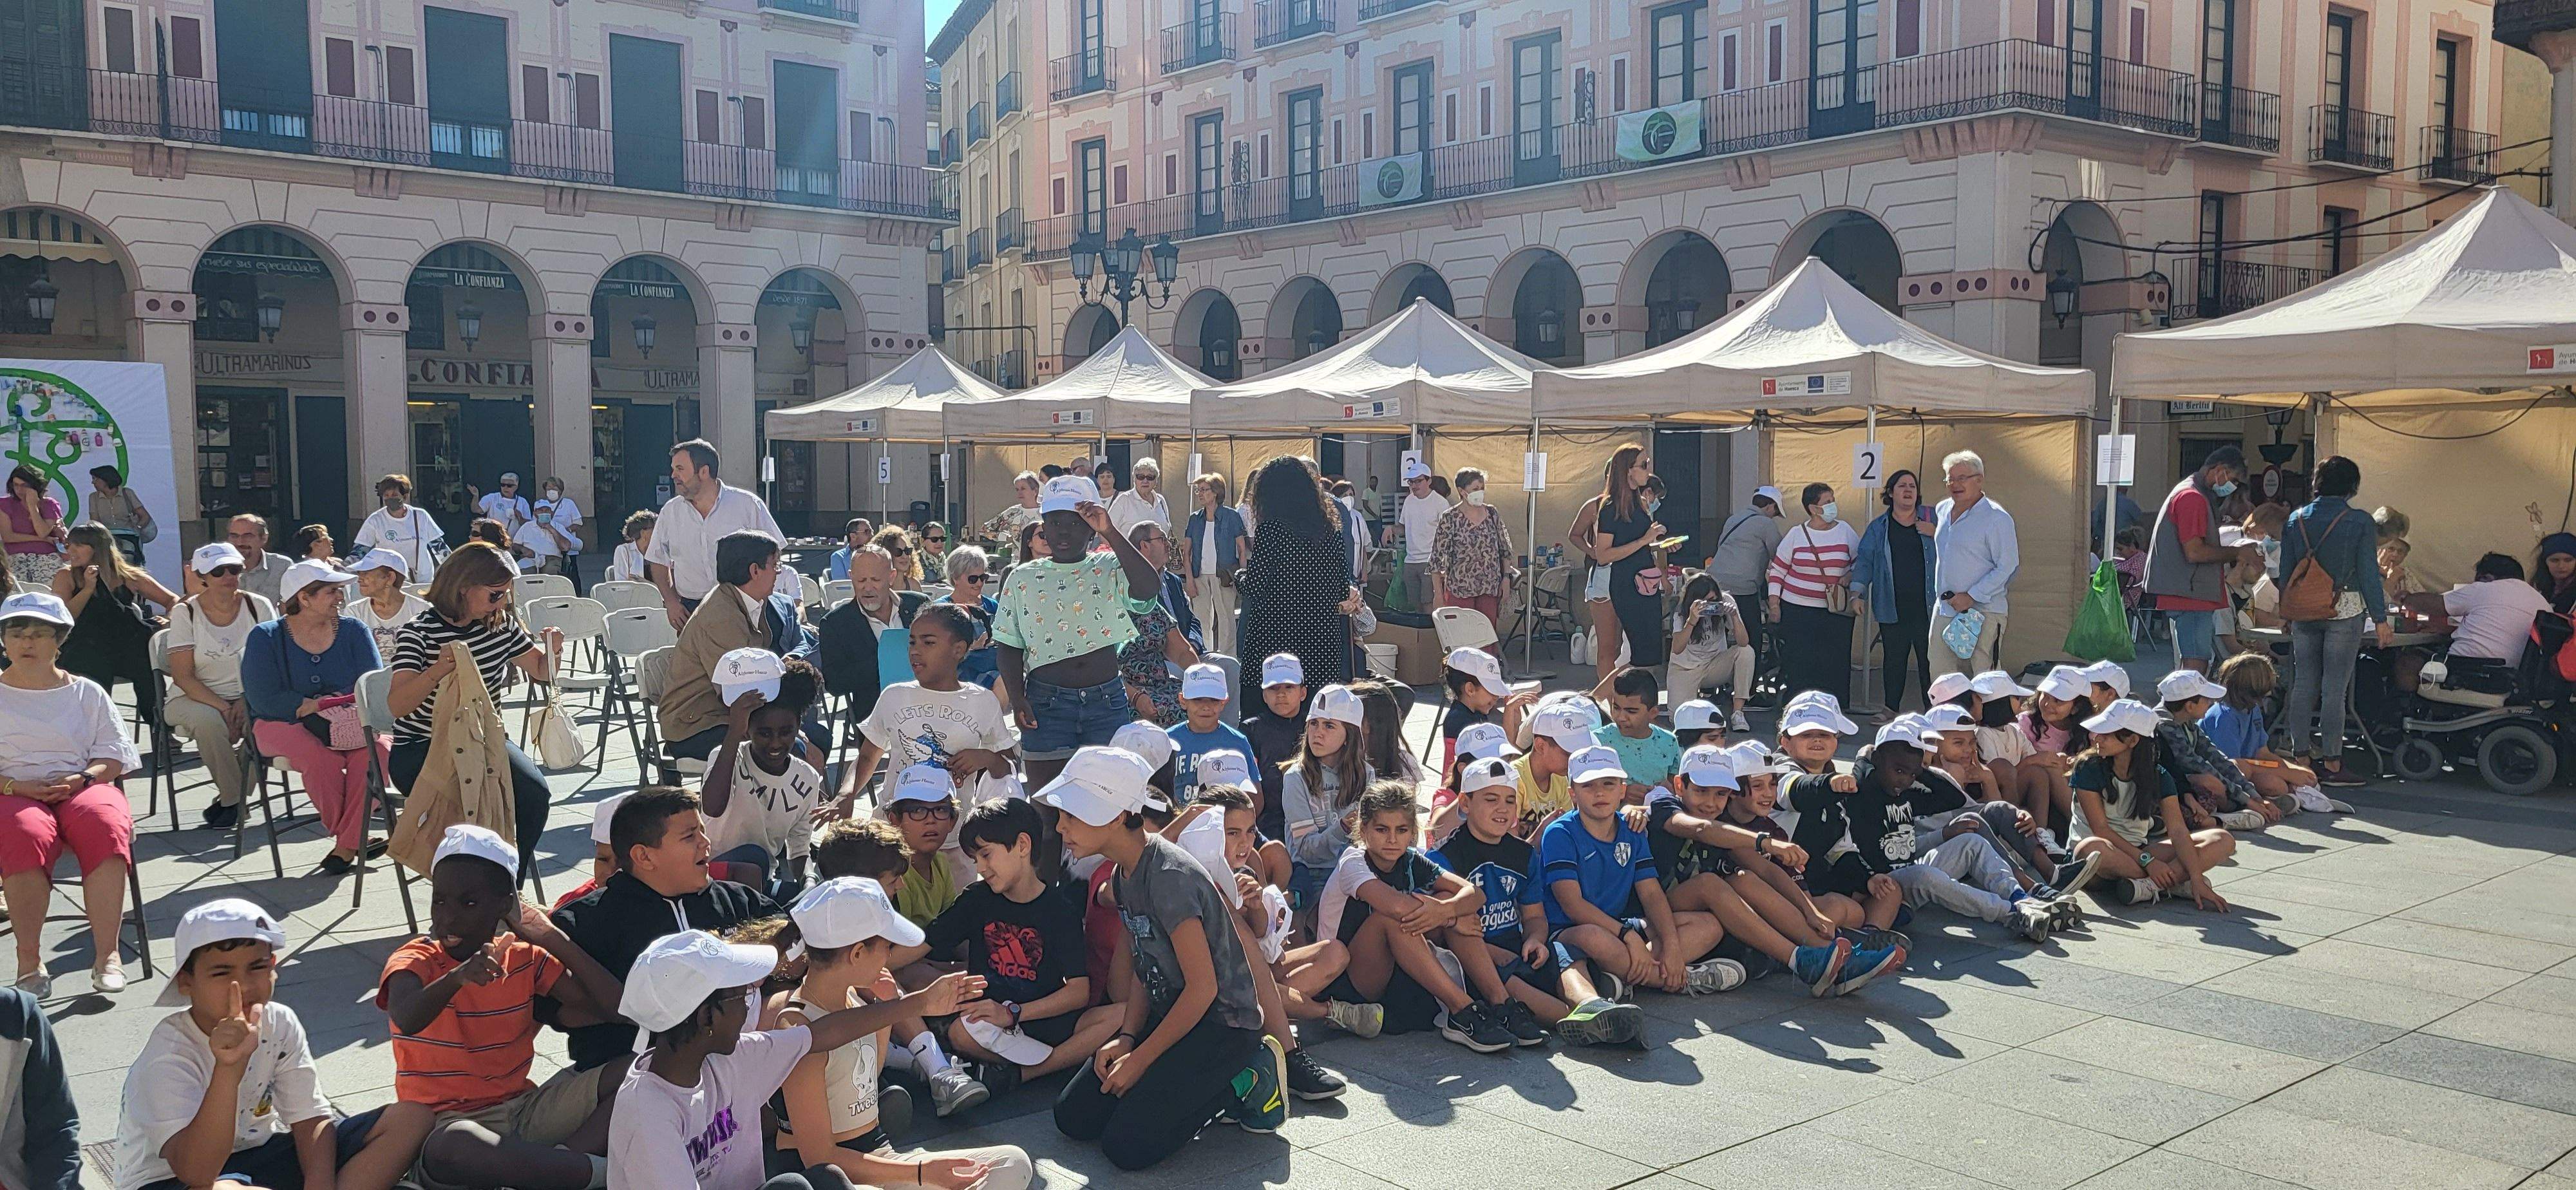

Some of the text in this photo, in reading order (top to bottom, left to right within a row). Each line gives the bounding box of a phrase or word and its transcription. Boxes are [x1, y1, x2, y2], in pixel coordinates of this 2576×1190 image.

[237, 260, 252, 269] sus
[454, 271, 505, 289] LA CONFIANZA
[630, 283, 675, 298] LA CONFIANZA
[200, 353, 312, 374] ULTRAMARINOS
[880, 462, 887, 479] 5
[1860, 451, 1876, 480] 2
[893, 703, 979, 734] LETS ROLL
[1489, 900, 1512, 915] grupo
